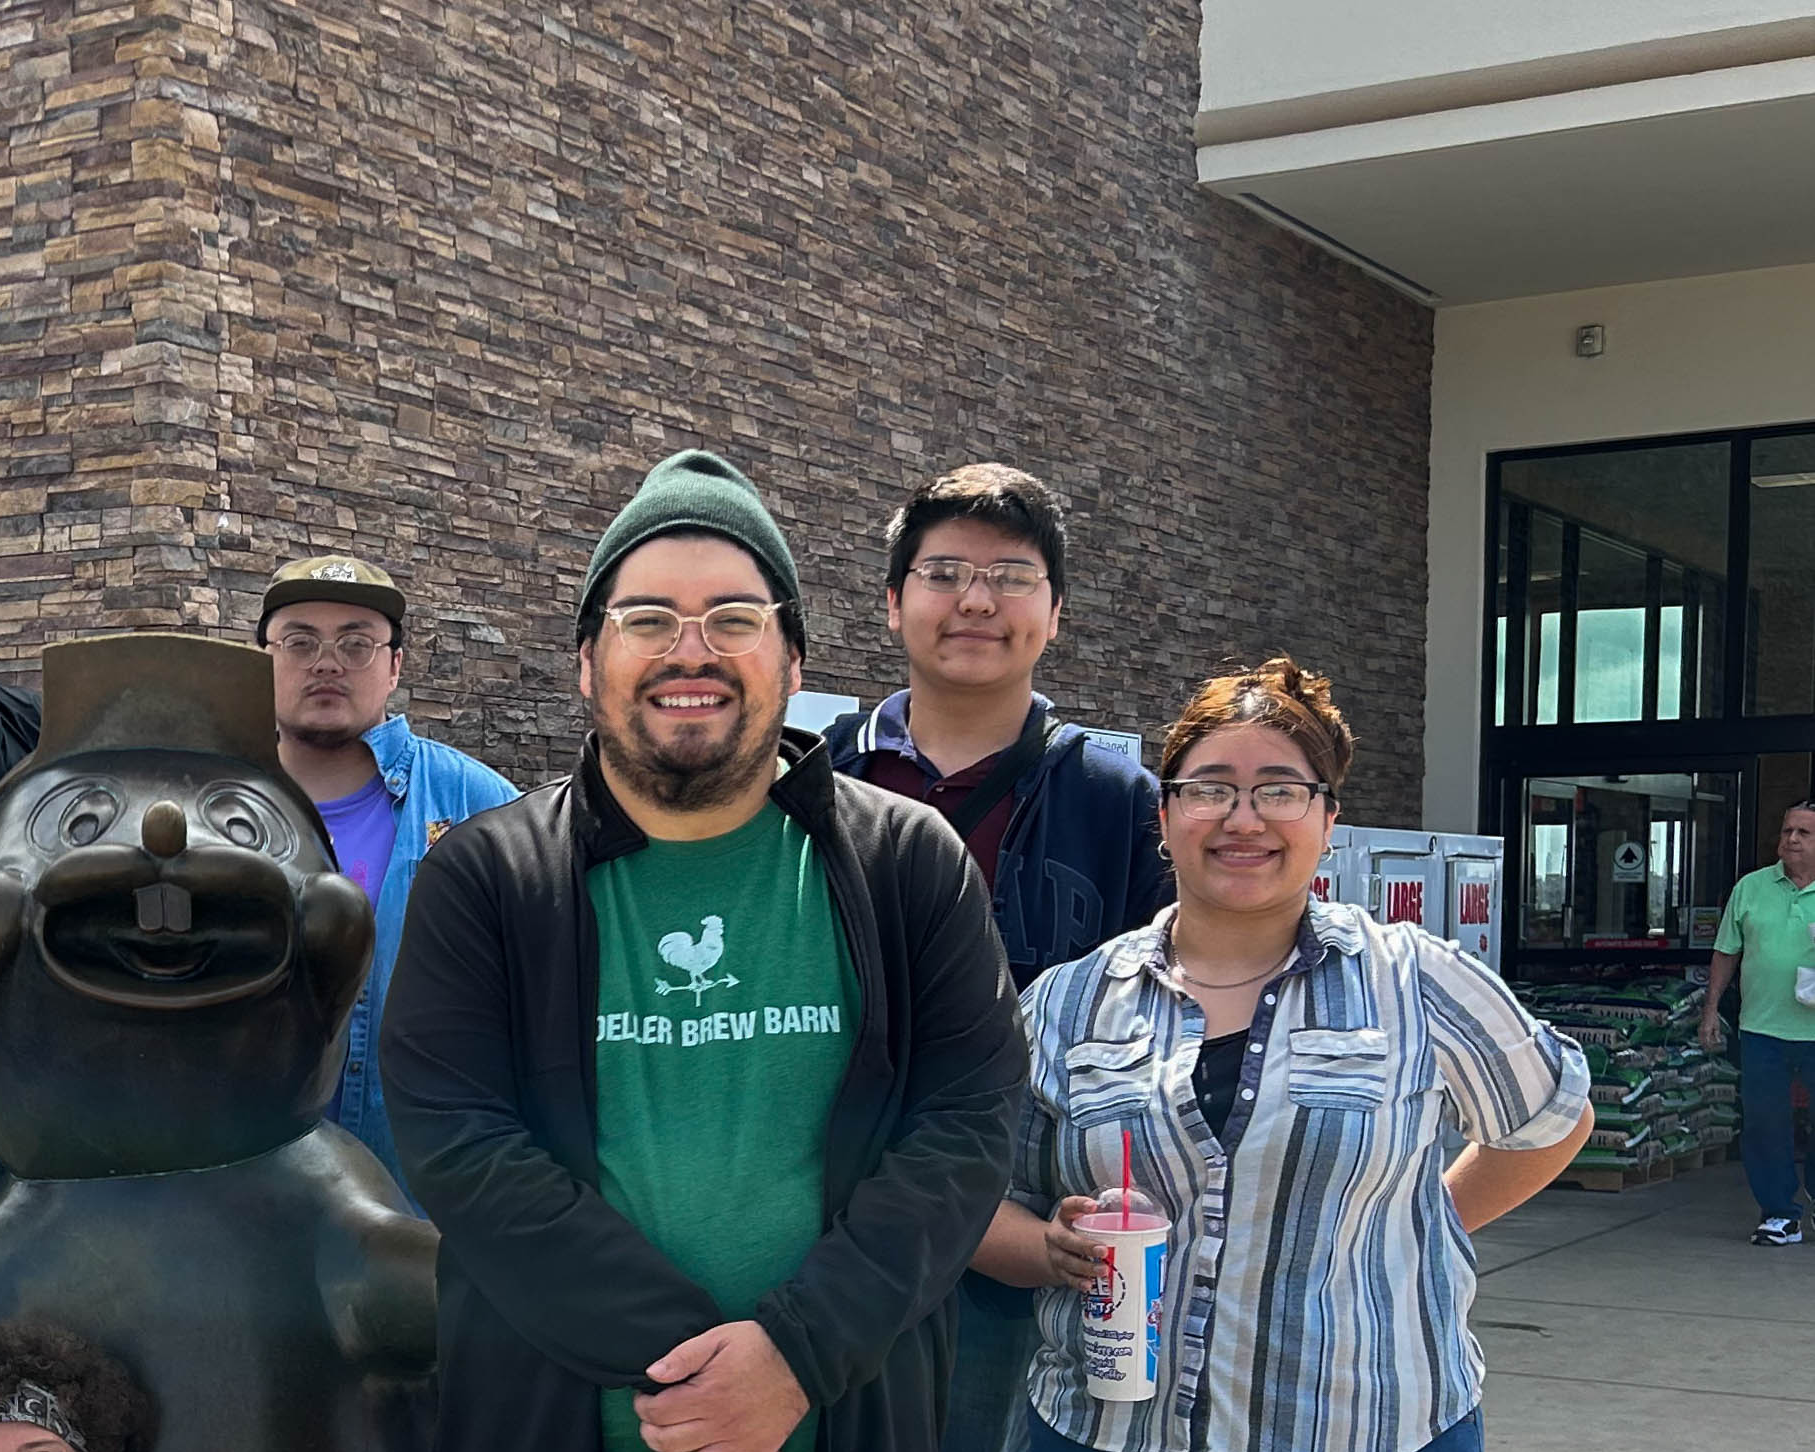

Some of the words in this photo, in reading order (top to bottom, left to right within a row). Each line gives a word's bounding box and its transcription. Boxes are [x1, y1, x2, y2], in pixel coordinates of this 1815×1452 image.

[1387, 881, 1423, 925] LARGE
[1459, 882, 1489, 925] LARGE
[681, 1011, 757, 1047] BREW
[764, 1005, 840, 1034] BARN
